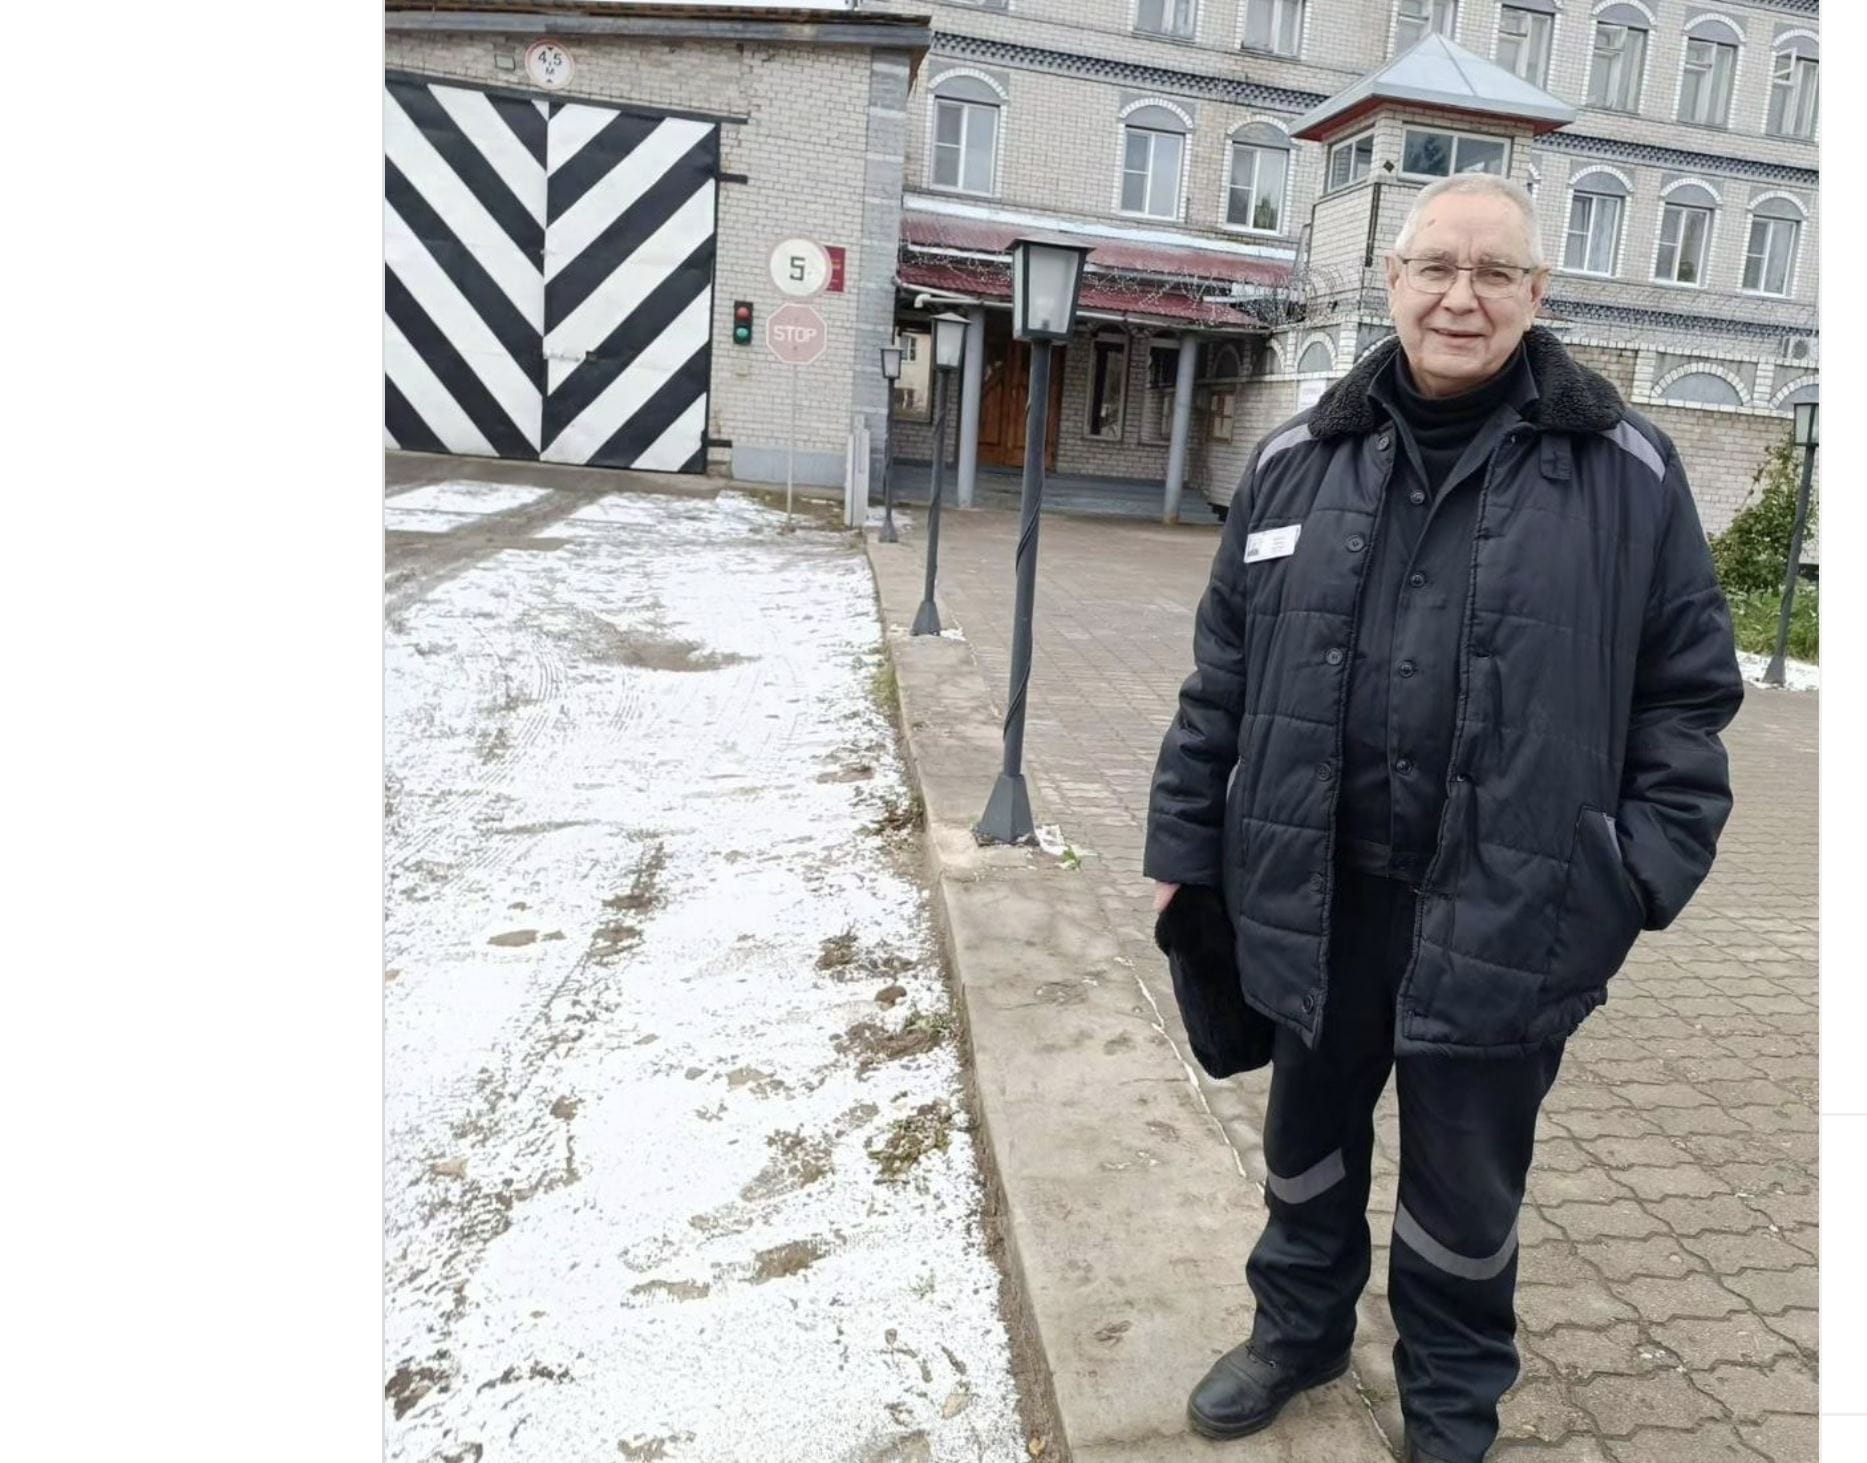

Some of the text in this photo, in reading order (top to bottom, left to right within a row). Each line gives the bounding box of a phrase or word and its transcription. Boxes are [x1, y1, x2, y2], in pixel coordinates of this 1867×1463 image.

[539, 51, 562, 66] 4,5
[789, 256, 806, 281] 5
[773, 325, 817, 342] STOP
